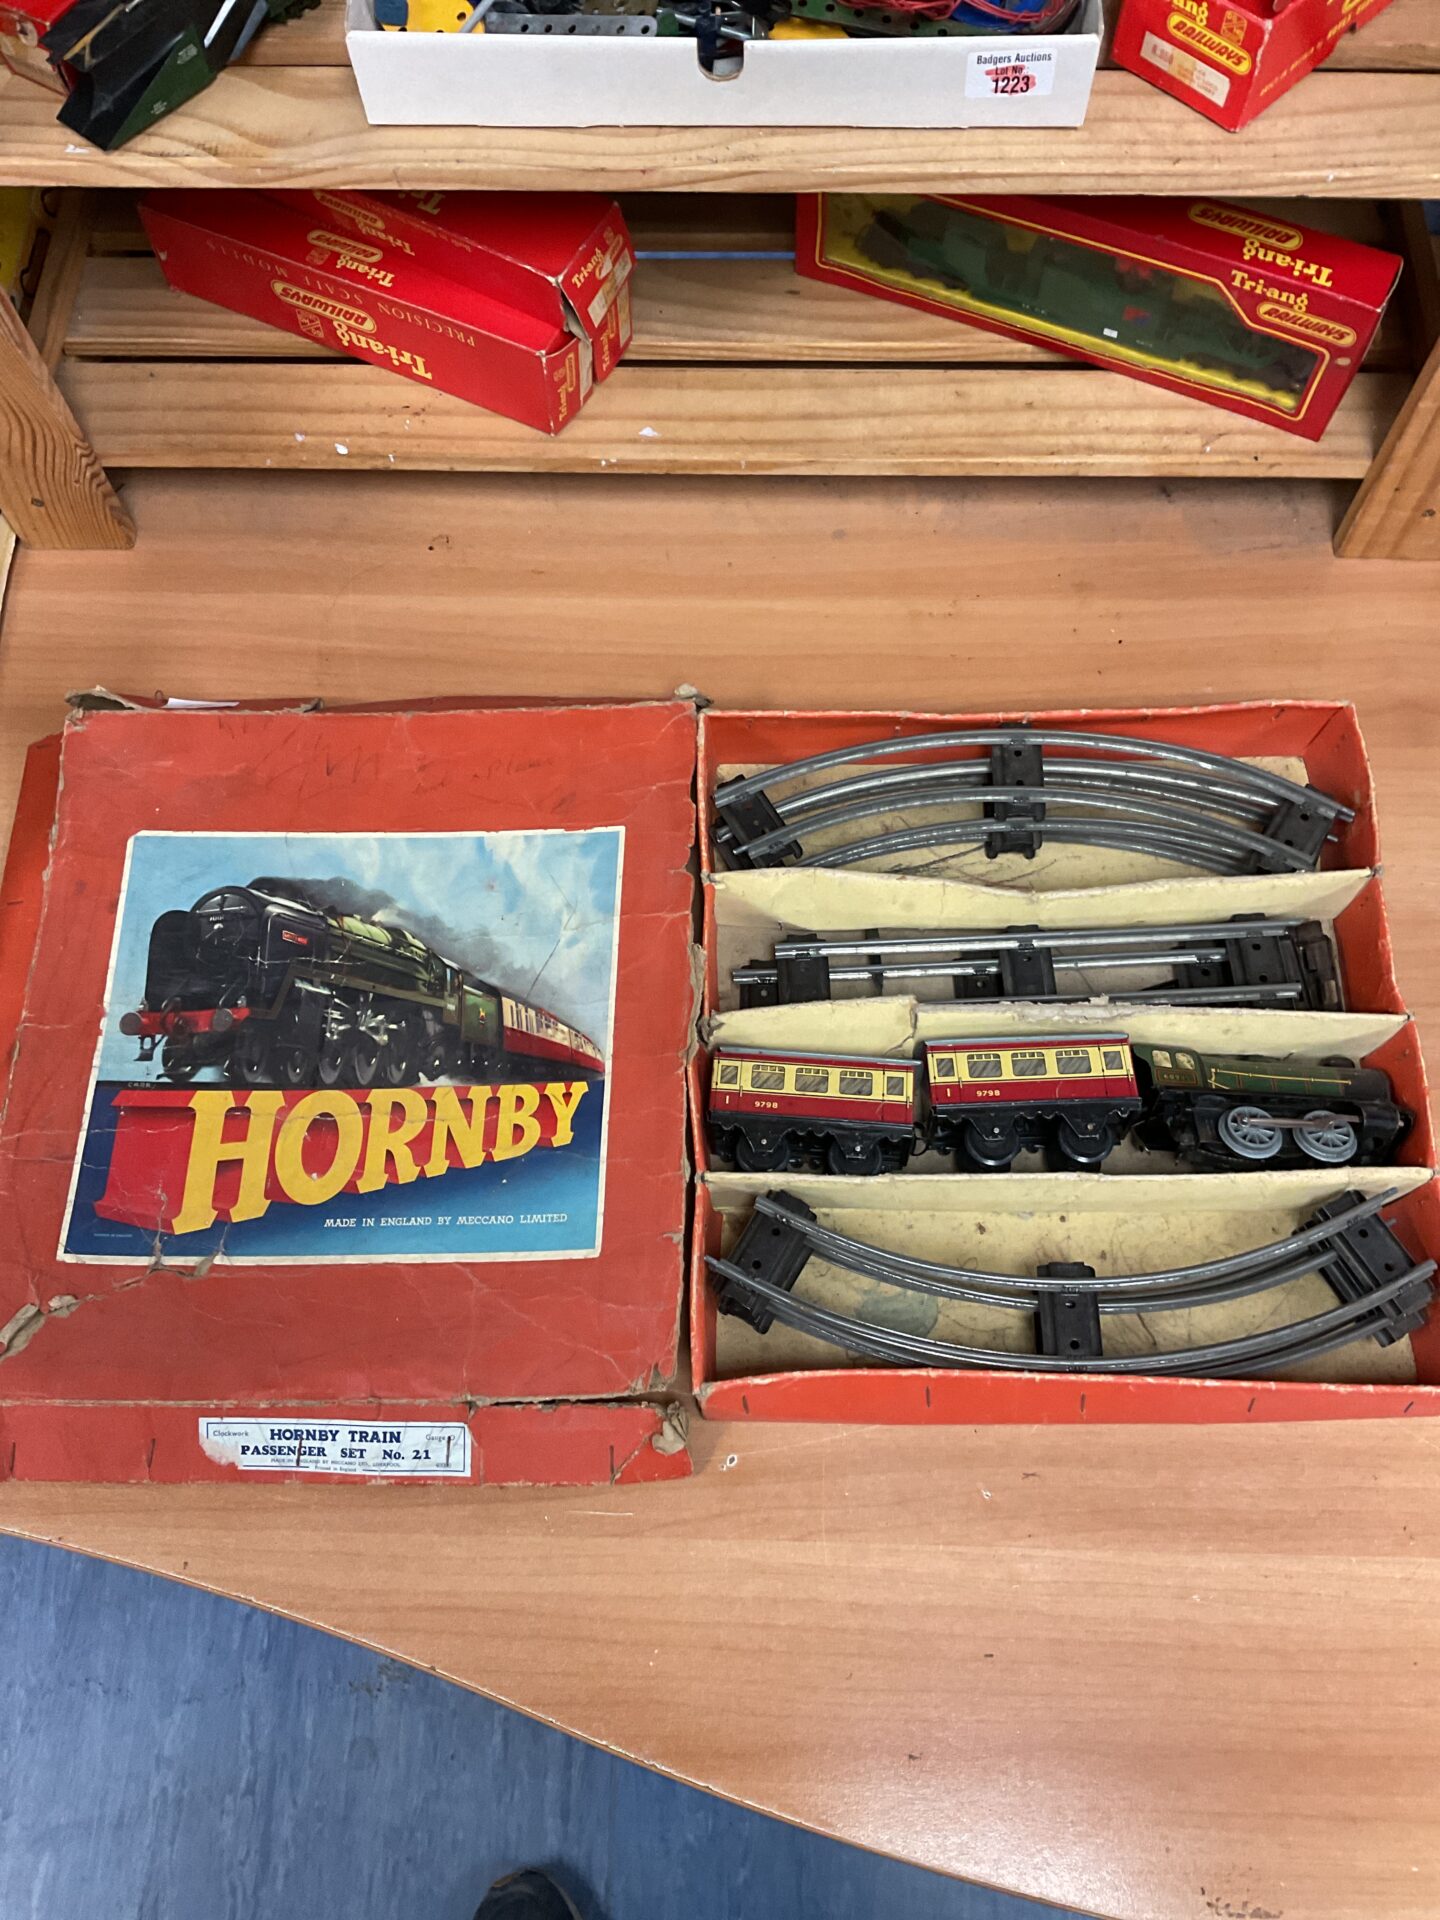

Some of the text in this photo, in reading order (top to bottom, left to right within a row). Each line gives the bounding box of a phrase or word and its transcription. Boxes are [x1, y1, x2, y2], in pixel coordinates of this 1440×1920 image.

[1173, 20, 1247, 66] RAILWAYS
[976, 53, 1052, 65] Badgers Auctions
[995, 66, 1009, 75] Lot
[992, 75, 1030, 94] 1223
[1194, 206, 1297, 244] RAILWAYS
[1243, 238, 1333, 287] Tri-ang
[1231, 270, 1309, 312] Tri-ang
[281, 286, 368, 328] RAILWAYS
[376, 301, 476, 347] PRECISION
[1262, 307, 1351, 341] RAILWAYS
[332, 320, 432, 380] Tri-ang
[754, 1101, 778, 1109] 9798
[171, 1081, 590, 1236] HORNBY
[324, 1213, 568, 1228] MADE IN ENGLAND BY MECCANO LIMITED
[213, 1429, 249, 1437] Clockwork
[270, 1428, 402, 1443] HORNBY TRAIN
[425, 1433, 446, 1442] Gauge
[241, 1445, 431, 1460] PASSENGER SET No. 21
